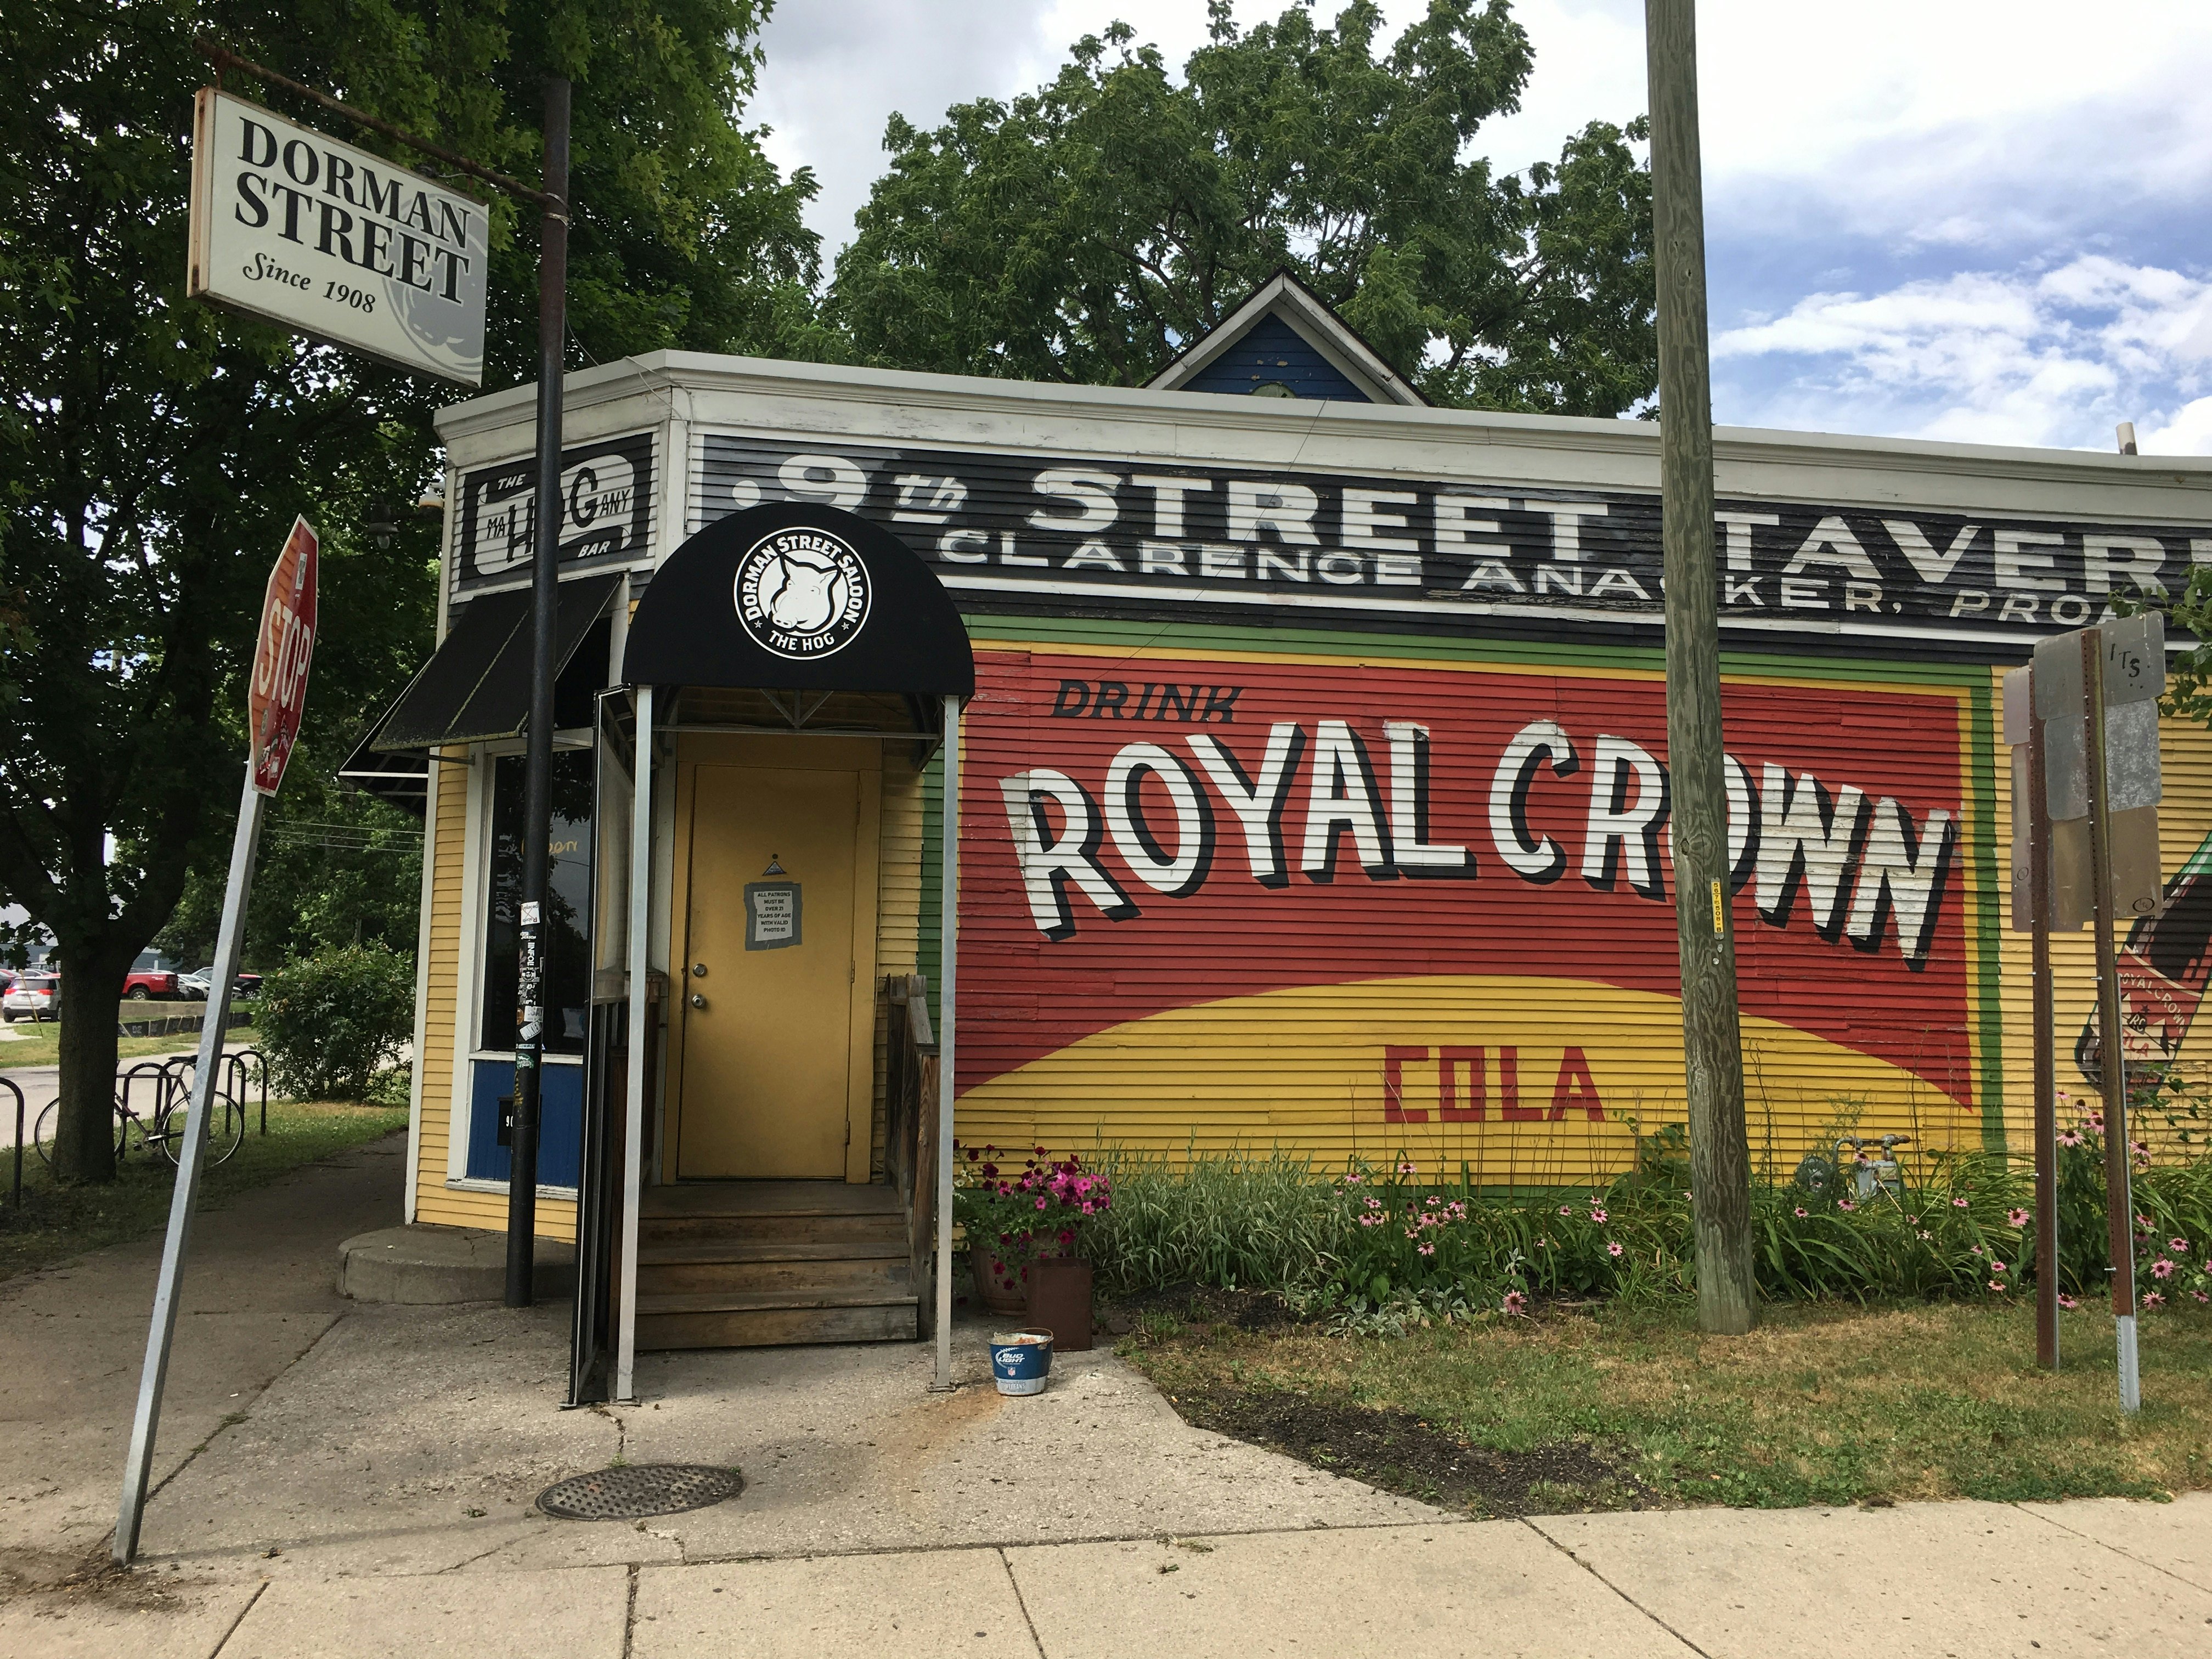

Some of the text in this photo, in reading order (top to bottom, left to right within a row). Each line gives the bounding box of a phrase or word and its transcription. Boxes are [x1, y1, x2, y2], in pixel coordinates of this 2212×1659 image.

[238, 116, 470, 249] DORMAN
[234, 171, 470, 305] STREET
[242, 252, 376, 313] Since 1908
[498, 473, 527, 490] THE
[578, 540, 611, 558] BAR
[939, 529, 1422, 586] CLARENCE
[1025, 467, 1609, 562] STREET
[1715, 511, 2212, 596] TAVER
[743, 535, 864, 623] DORMAN STREET SALOON
[258, 597, 311, 712] STOP
[769, 630, 834, 651] THE HOG
[1051, 679, 1244, 723] DRINK
[998, 720, 1477, 942] ROYAL
[2129, 1013, 2146, 1031] RC
[2154, 986, 2185, 1035] CROWN
[1384, 1045, 1606, 1124] COLA
